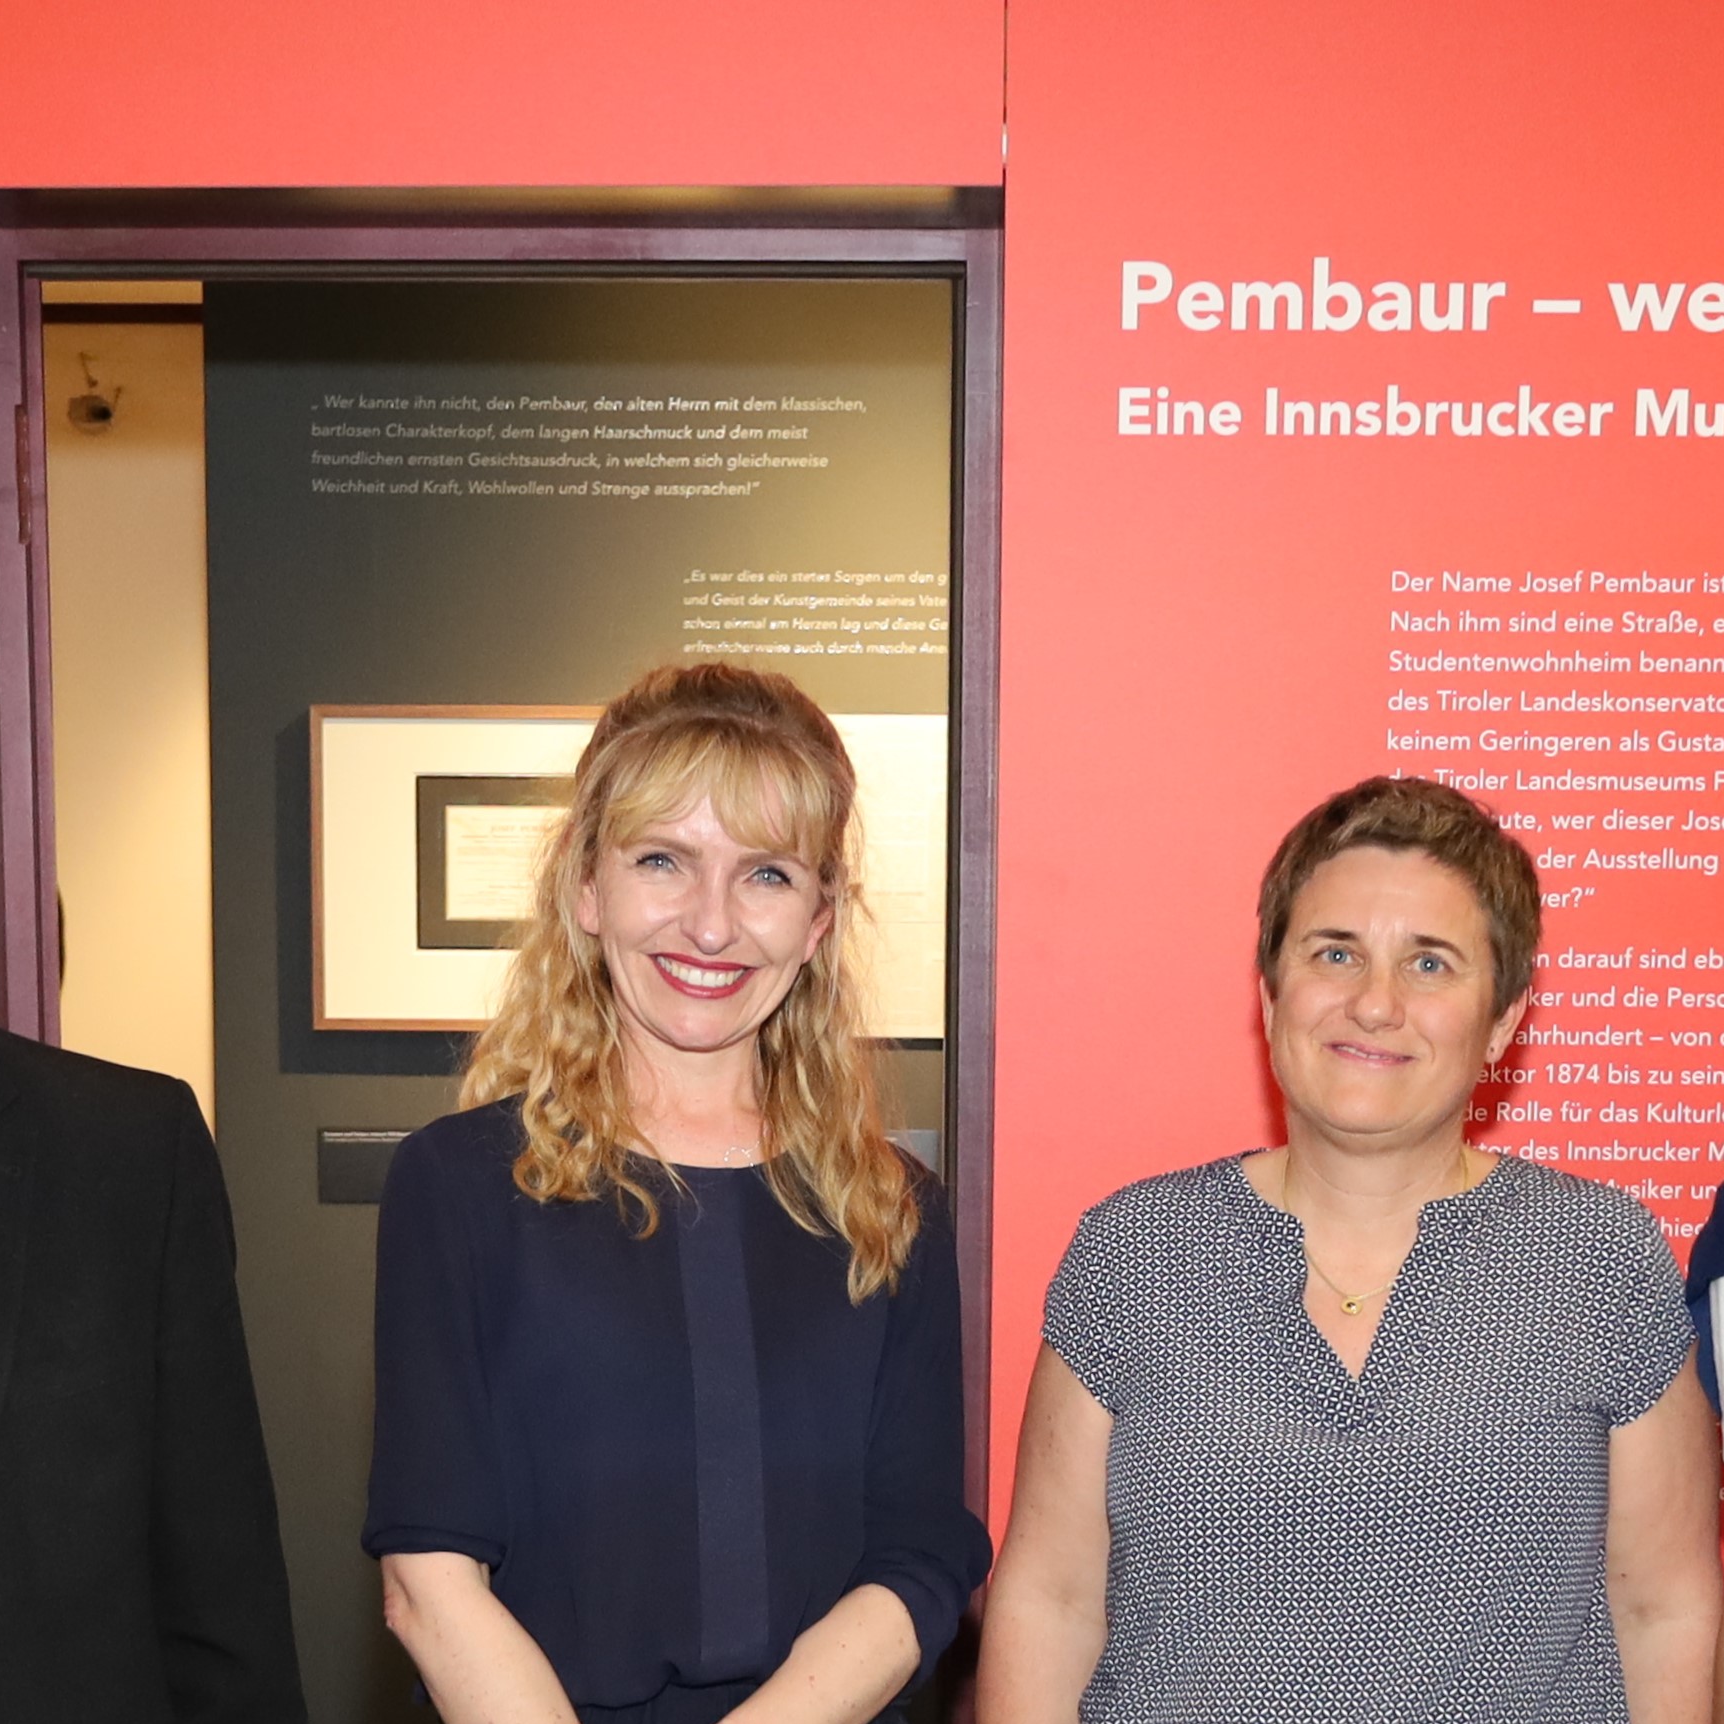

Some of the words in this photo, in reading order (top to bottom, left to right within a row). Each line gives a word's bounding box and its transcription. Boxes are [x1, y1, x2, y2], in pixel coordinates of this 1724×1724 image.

[1121, 257, 1506, 332] Pembaur
[325, 395, 354, 409] Wer
[358, 395, 409, 410] kannte
[414, 395, 436, 410] ihn
[441, 395, 480, 413] nicht,
[486, 395, 514, 411] den
[519, 396, 588, 414] Pembaur,
[593, 396, 623, 411] den
[627, 396, 664, 412] alten
[715, 396, 739, 412] mit
[743, 396, 777, 412] dem
[781, 396, 867, 413] klassischen,
[1118, 386, 1242, 436] Eine
[1265, 384, 1614, 437] Innsbrucker
[311, 422, 381, 438] bartlosen
[385, 422, 496, 441] Charakterkopf,
[501, 424, 534, 439] dem
[539, 424, 589, 443] langen
[594, 424, 692, 440] Haarschmuck
[697, 424, 726, 440] und
[729, 424, 764, 440] dem
[767, 425, 809, 440] meist
[311, 450, 403, 466] freundlichen
[408, 453, 463, 467] ernsten
[468, 452, 601, 469] Gesichtsausdruck,
[606, 453, 620, 467] in
[624, 452, 691, 468] welchem
[693, 453, 723, 468] sich
[727, 453, 829, 471] gleicherweise
[312, 478, 385, 494] Weichheit
[390, 479, 419, 494] und
[423, 479, 463, 497] Kraft,
[468, 480, 554, 496] Wohlwollen
[558, 480, 587, 496] und
[710, 572, 734, 583] war
[737, 569, 764, 583] dies
[834, 570, 881, 586] Sorgen
[884, 573, 905, 584] um
[1391, 570, 1434, 593] Der
[1442, 571, 1512, 593] Name
[1518, 570, 1584, 593] Josef
[1590, 570, 1696, 594] Pembaur
[683, 593, 709, 606] und
[919, 594, 947, 607] Vate
[929, 618, 947, 631] Ge
[1390, 609, 1450, 632] Nach
[1458, 609, 1501, 632] ihm
[1508, 610, 1557, 633] sind
[1564, 611, 1614, 633] eine
[1621, 610, 1704, 637] Straße,
[1389, 649, 1632, 673] Studentenwohnheim
[1387, 688, 1429, 712] des
[1436, 689, 1513, 712] Tiroler
[1387, 728, 1471, 751] keinem
[1478, 729, 1611, 757] Geringeren
[1619, 729, 1650, 752] als
[1433, 768, 1509, 790] Tiroler
[1516, 768, 1706, 792] Landesmuseums
[1498, 811, 1543, 833] ute,
[1551, 815, 1596, 830] wer
[1602, 808, 1675, 831] dieser
[1536, 846, 1577, 869] der
[1582, 847, 1719, 875] Ausstellung
[1558, 946, 1634, 969] darauf
[1639, 947, 1687, 970] sind
[1528, 985, 1564, 1007] ker
[1571, 985, 1616, 1008] und
[1622, 985, 1659, 1008] die
[1514, 1023, 1643, 1047] ahrhundert
[1670, 1031, 1712, 1047] von
[1478, 1062, 1537, 1084] ektor
[1545, 1063, 1601, 1084] 1874
[1607, 1062, 1641, 1085] bis
[1647, 1070, 1673, 1085] zu
[1496, 1100, 1553, 1123] Rolle
[1560, 1100, 1593, 1123] für
[1599, 1101, 1639, 1123] das
[1518, 1138, 1560, 1161] des
[1567, 1139, 1701, 1162] Innsbrucker
